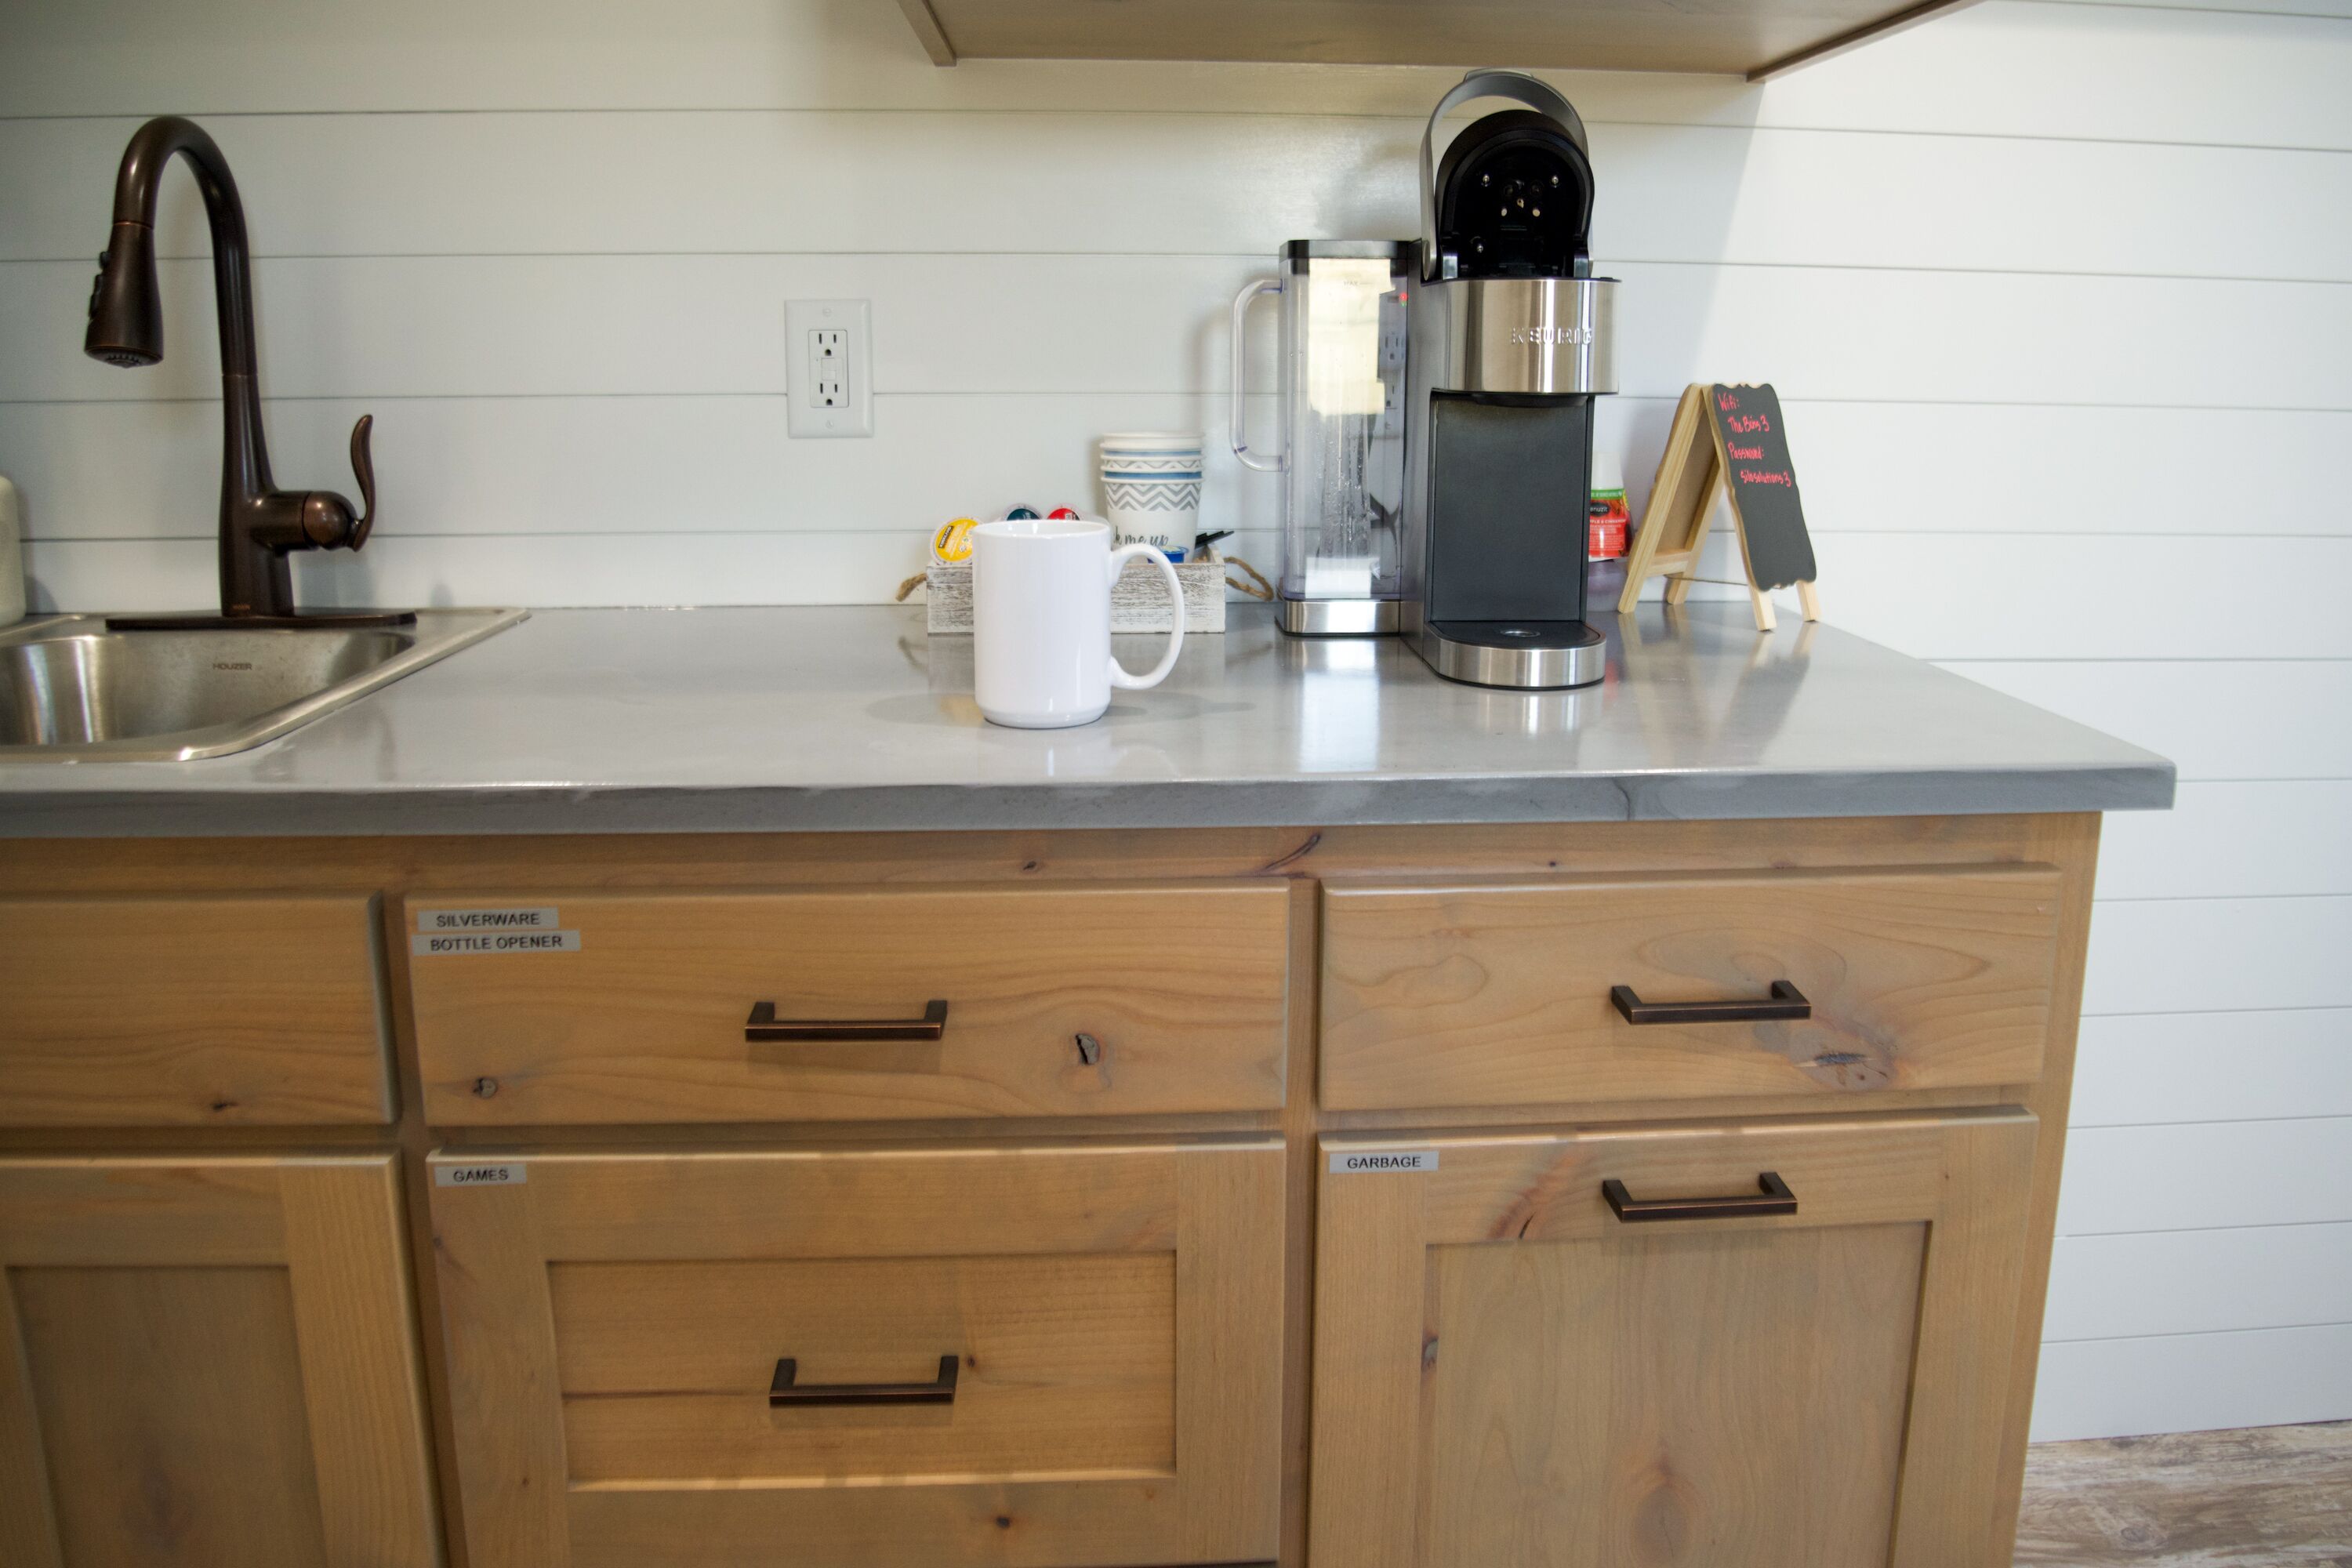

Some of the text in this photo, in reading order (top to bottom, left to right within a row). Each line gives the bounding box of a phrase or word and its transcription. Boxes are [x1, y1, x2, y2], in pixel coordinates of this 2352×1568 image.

[1511, 326, 1593, 345] KEURIG
[1727, 416, 1744, 433] The
[436, 913, 540, 927] SILVERWARE
[430, 934, 563, 951] BOTTLE OPENER
[1347, 1156, 1421, 1169] GARBAGE
[453, 1168, 509, 1183] GAMES
